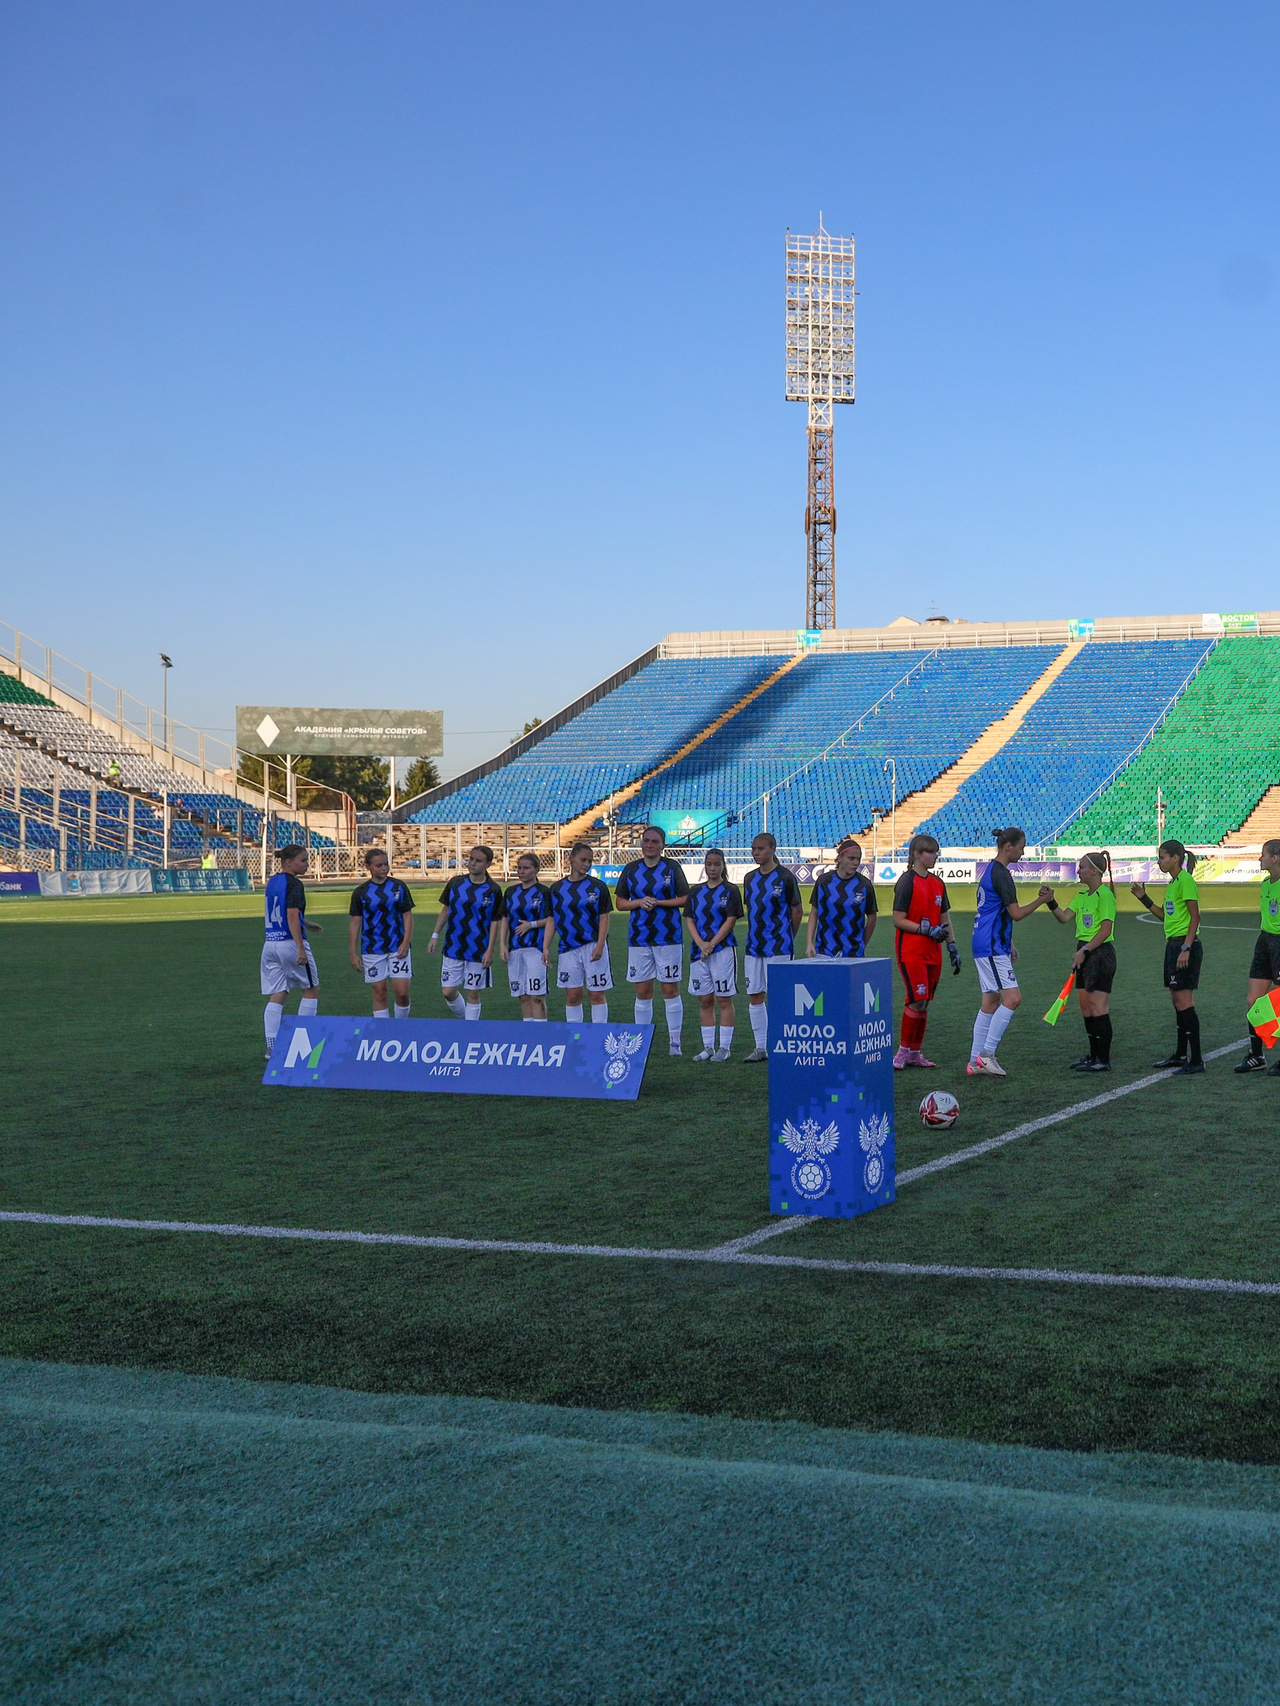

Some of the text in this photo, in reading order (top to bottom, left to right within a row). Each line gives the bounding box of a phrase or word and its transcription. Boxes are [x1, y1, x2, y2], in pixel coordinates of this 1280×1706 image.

[294, 725, 428, 735] АКАДЕМИЯ «КРЫЛЬЯ СОВЕТОВ»
[1045, 868, 1064, 877] банк
[391, 961, 410, 974] 34
[664, 964, 679, 979] 12
[467, 972, 482, 986] 27
[528, 978, 541, 991] 18
[591, 973, 607, 986] 15
[715, 979, 730, 994] 11
[783, 1024, 836, 1038] МОЛО
[858, 1019, 886, 1038] МОЛО
[773, 1040, 847, 1055] ДЕЖНАЯ
[853, 1033, 892, 1055] ДЕЖНАЯ
[355, 1038, 567, 1068] МОЛОДЕЖНАЯ
